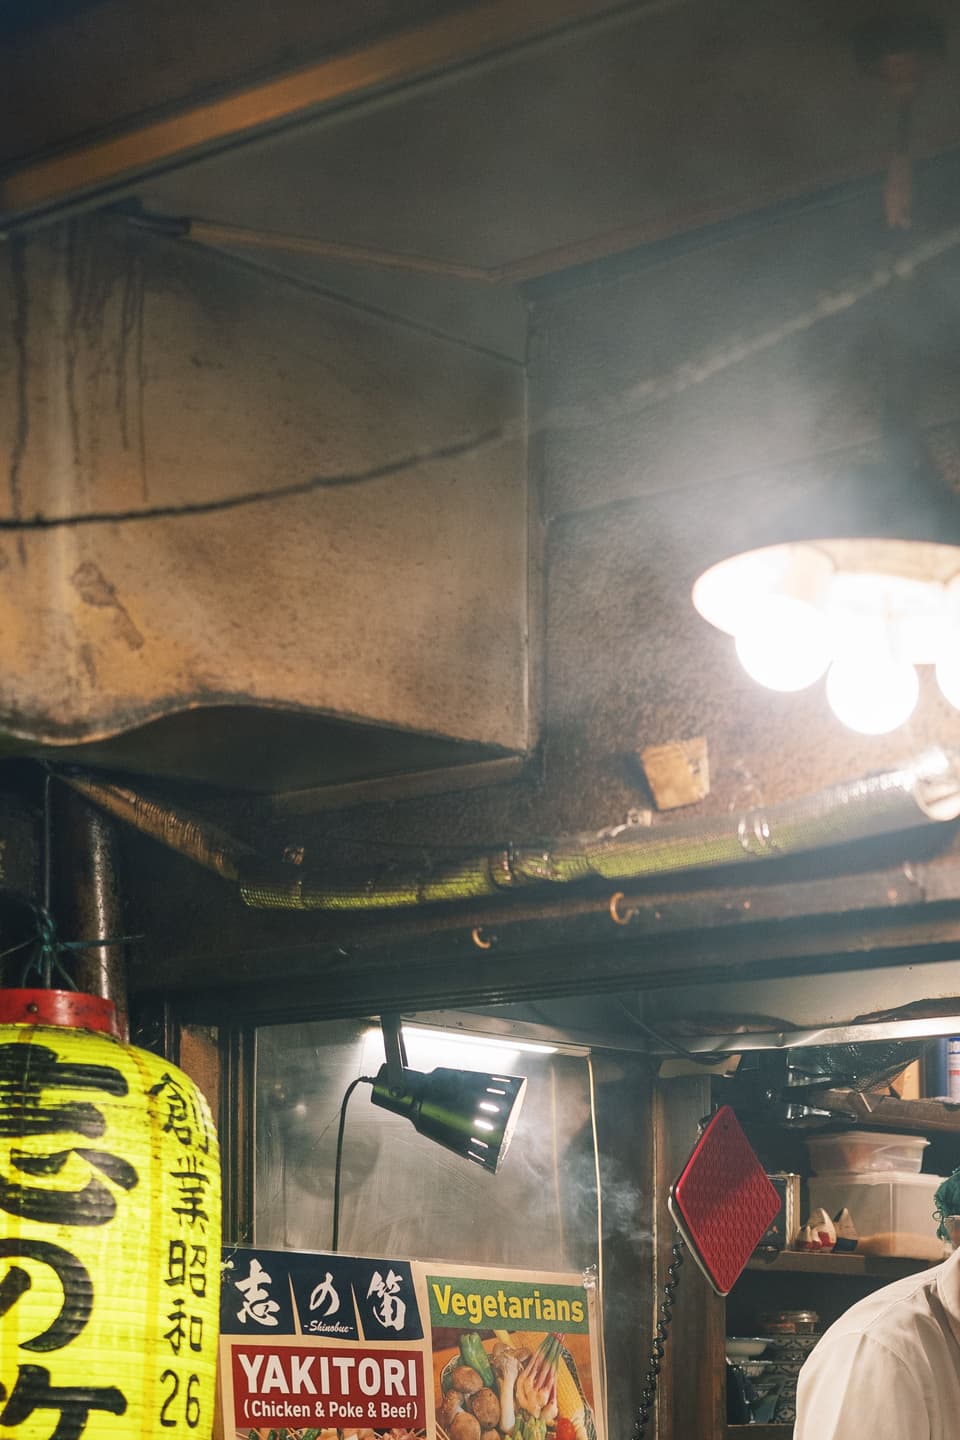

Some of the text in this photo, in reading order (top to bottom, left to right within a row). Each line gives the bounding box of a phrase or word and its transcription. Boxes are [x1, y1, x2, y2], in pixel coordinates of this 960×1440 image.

[234, 1257, 407, 1331] 志の笛
[432, 1283, 584, 1324] Vegetarians
[237, 1353, 417, 1398] YAKITORI
[243, 1398, 418, 1420] (Chicken & Poke & Beef)
